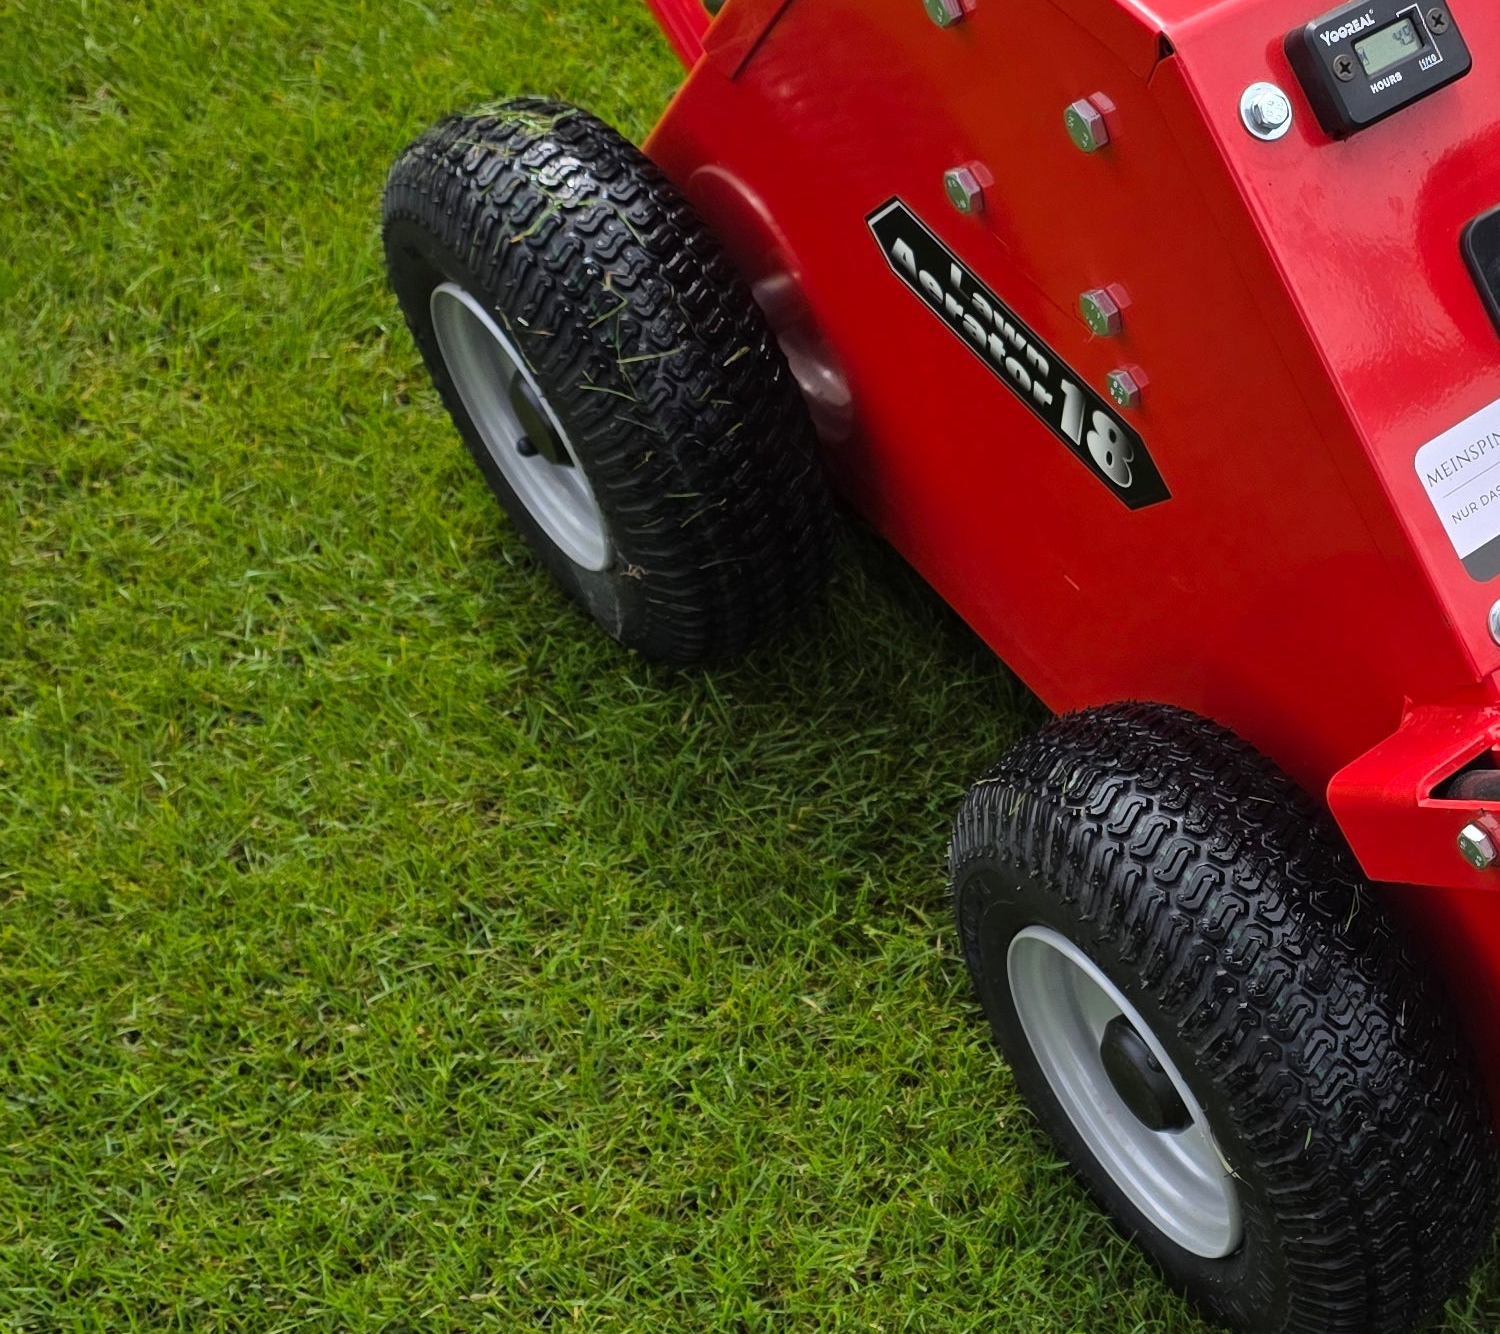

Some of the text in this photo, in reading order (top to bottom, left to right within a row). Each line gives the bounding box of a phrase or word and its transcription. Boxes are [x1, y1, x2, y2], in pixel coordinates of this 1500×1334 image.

[1320, 12, 1375, 47] YOOREAL
[1370, 72, 1403, 94] HOURS
[891, 237, 1054, 408] Aerator
[949, 262, 1051, 378] Lawn
[1060, 378, 1135, 489] 18
[1451, 502, 1478, 524] NUR
